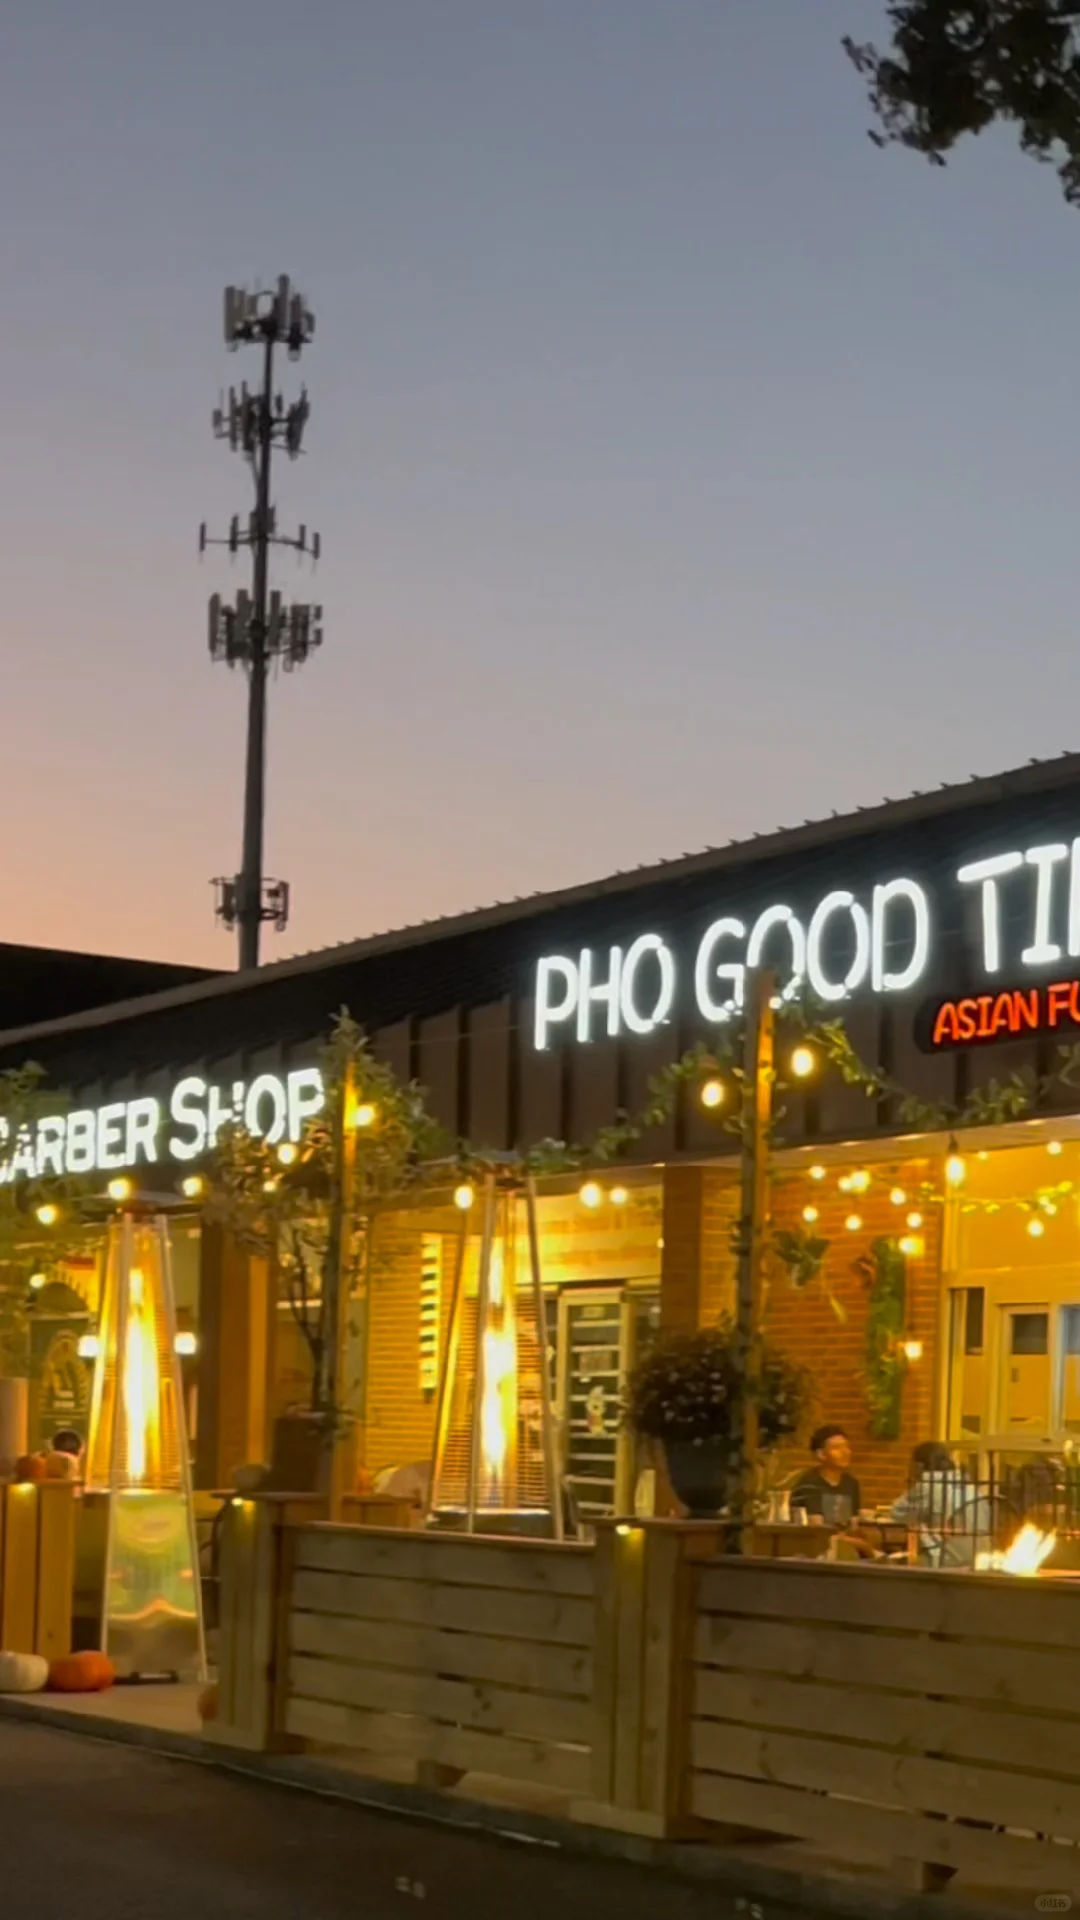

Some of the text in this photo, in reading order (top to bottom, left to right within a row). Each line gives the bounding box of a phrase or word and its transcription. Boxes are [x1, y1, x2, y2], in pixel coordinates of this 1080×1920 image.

[534, 836, 1080, 1050] PHO GOOD TI
[933, 990, 1038, 1043] ASIAN
[169, 1068, 325, 1160] SHOP
